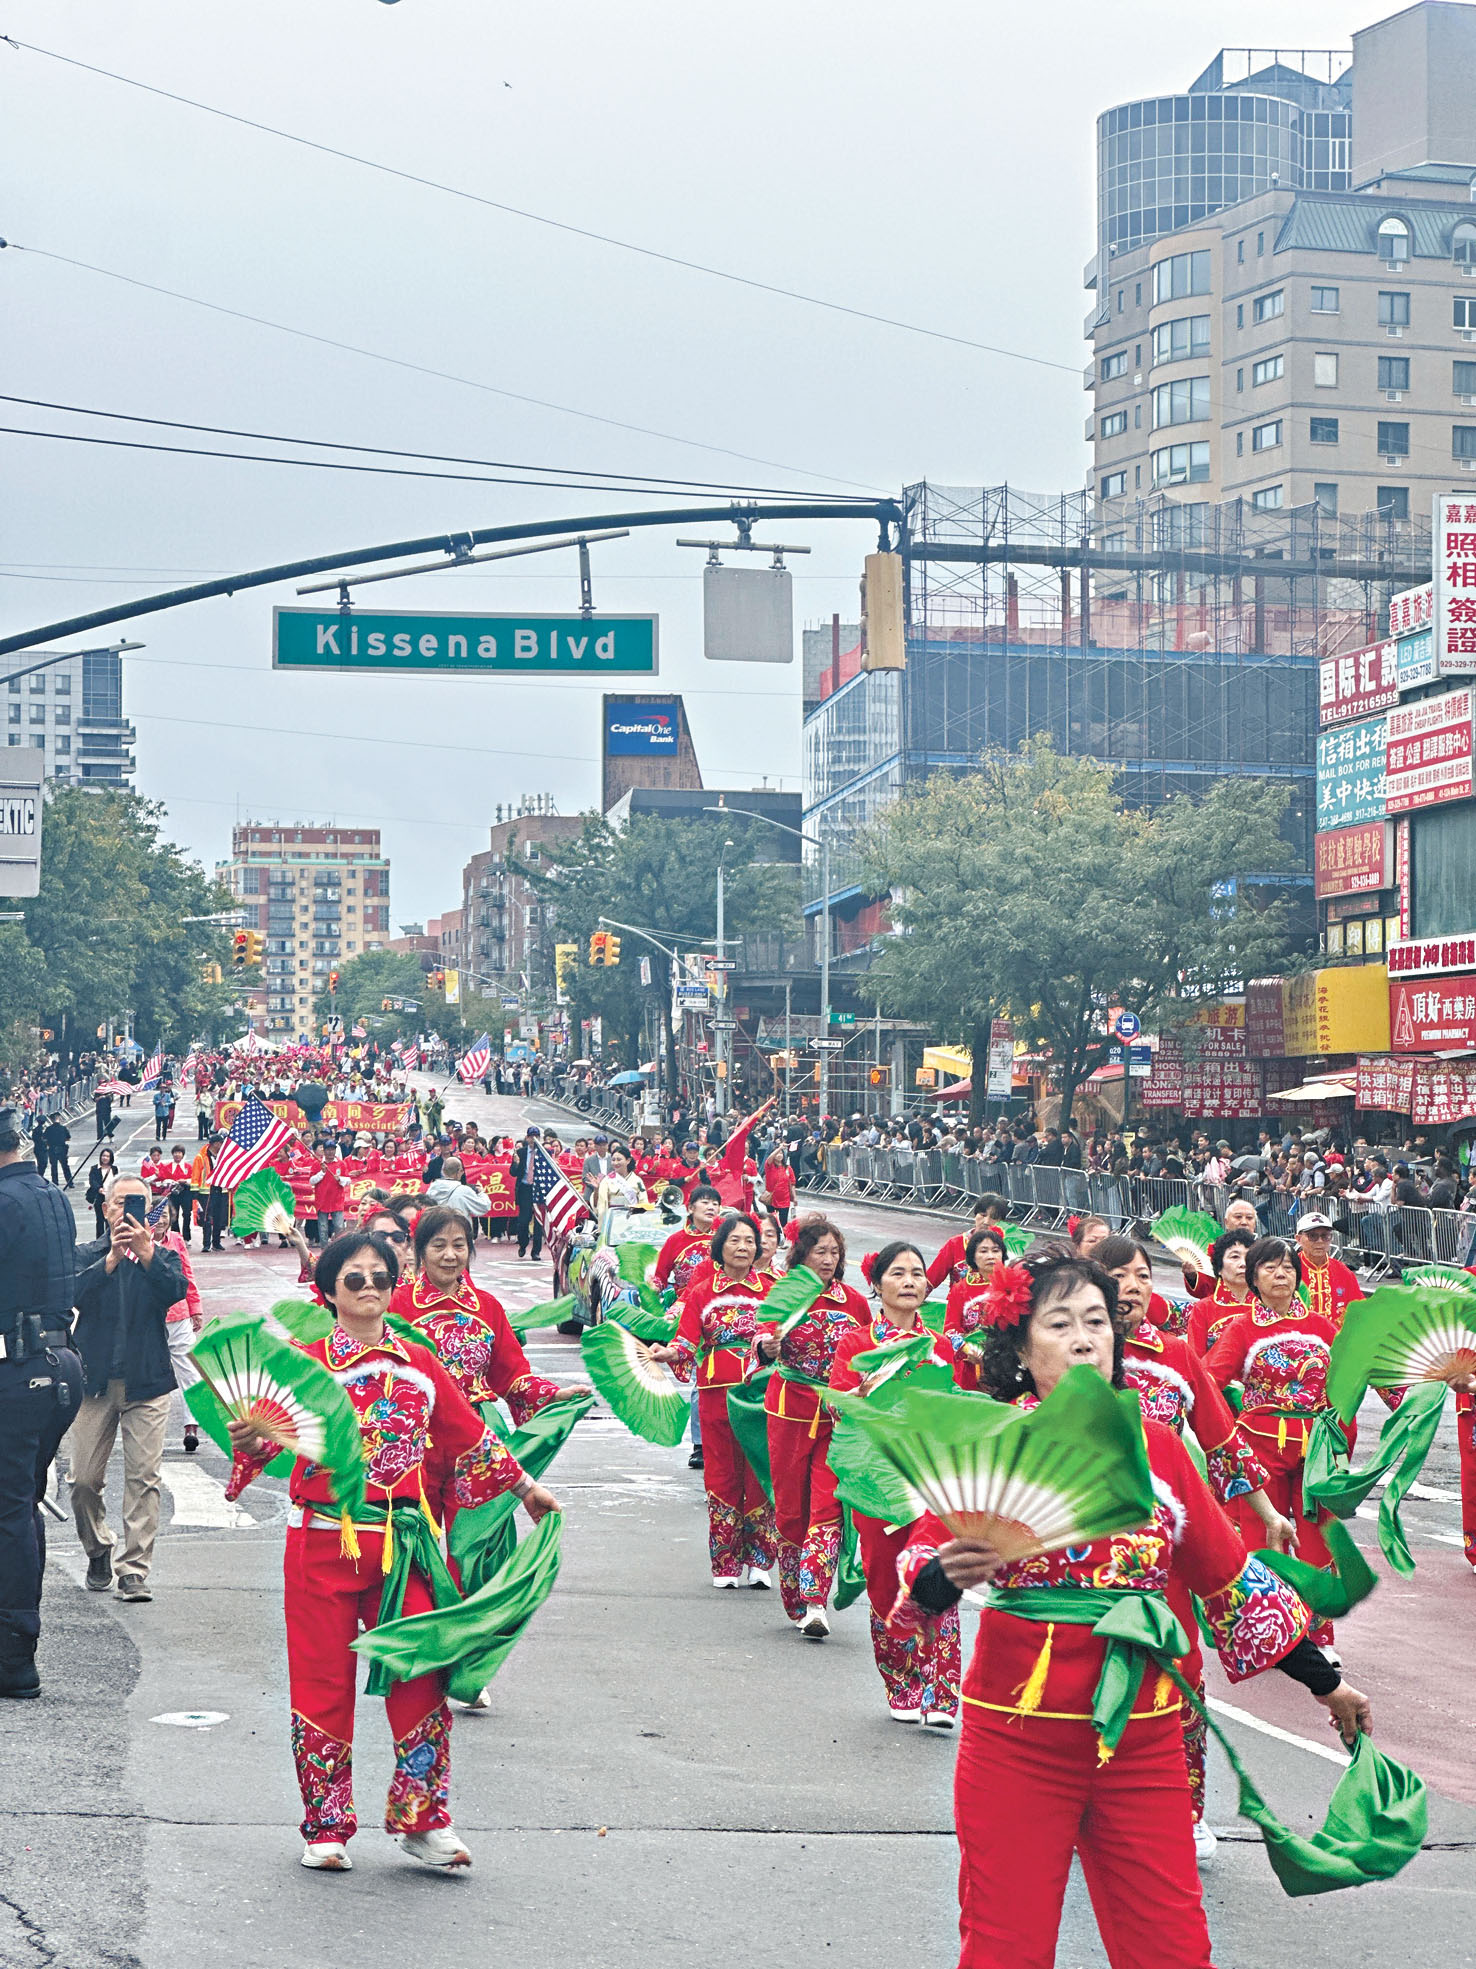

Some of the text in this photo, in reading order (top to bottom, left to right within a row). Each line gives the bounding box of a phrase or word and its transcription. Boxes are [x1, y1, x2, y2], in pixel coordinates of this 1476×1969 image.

[1446, 532, 1476, 654] 照相簽證
[316, 624, 615, 660] Kissena Blvd
[1321, 690, 1399, 721] TEL:9172165959
[1319, 725, 1387, 766] 信箱出租
[1319, 755, 1387, 781] MAIL BOX FOR REN
[1412, 990, 1476, 1024] 頂好西藥房
[1160, 1041, 1174, 1049] SIM
[1221, 1042, 1241, 1050] SALE
[1391, 1068, 1412, 1076] PHOTO
[1358, 1072, 1413, 1092] 快速照相
[1144, 1090, 1179, 1098] TRANSFER
[1358, 1089, 1410, 1108] 信箱出租
[1184, 1109, 1250, 1118] 汇款中国
[346, 1120, 397, 1130] Associati
